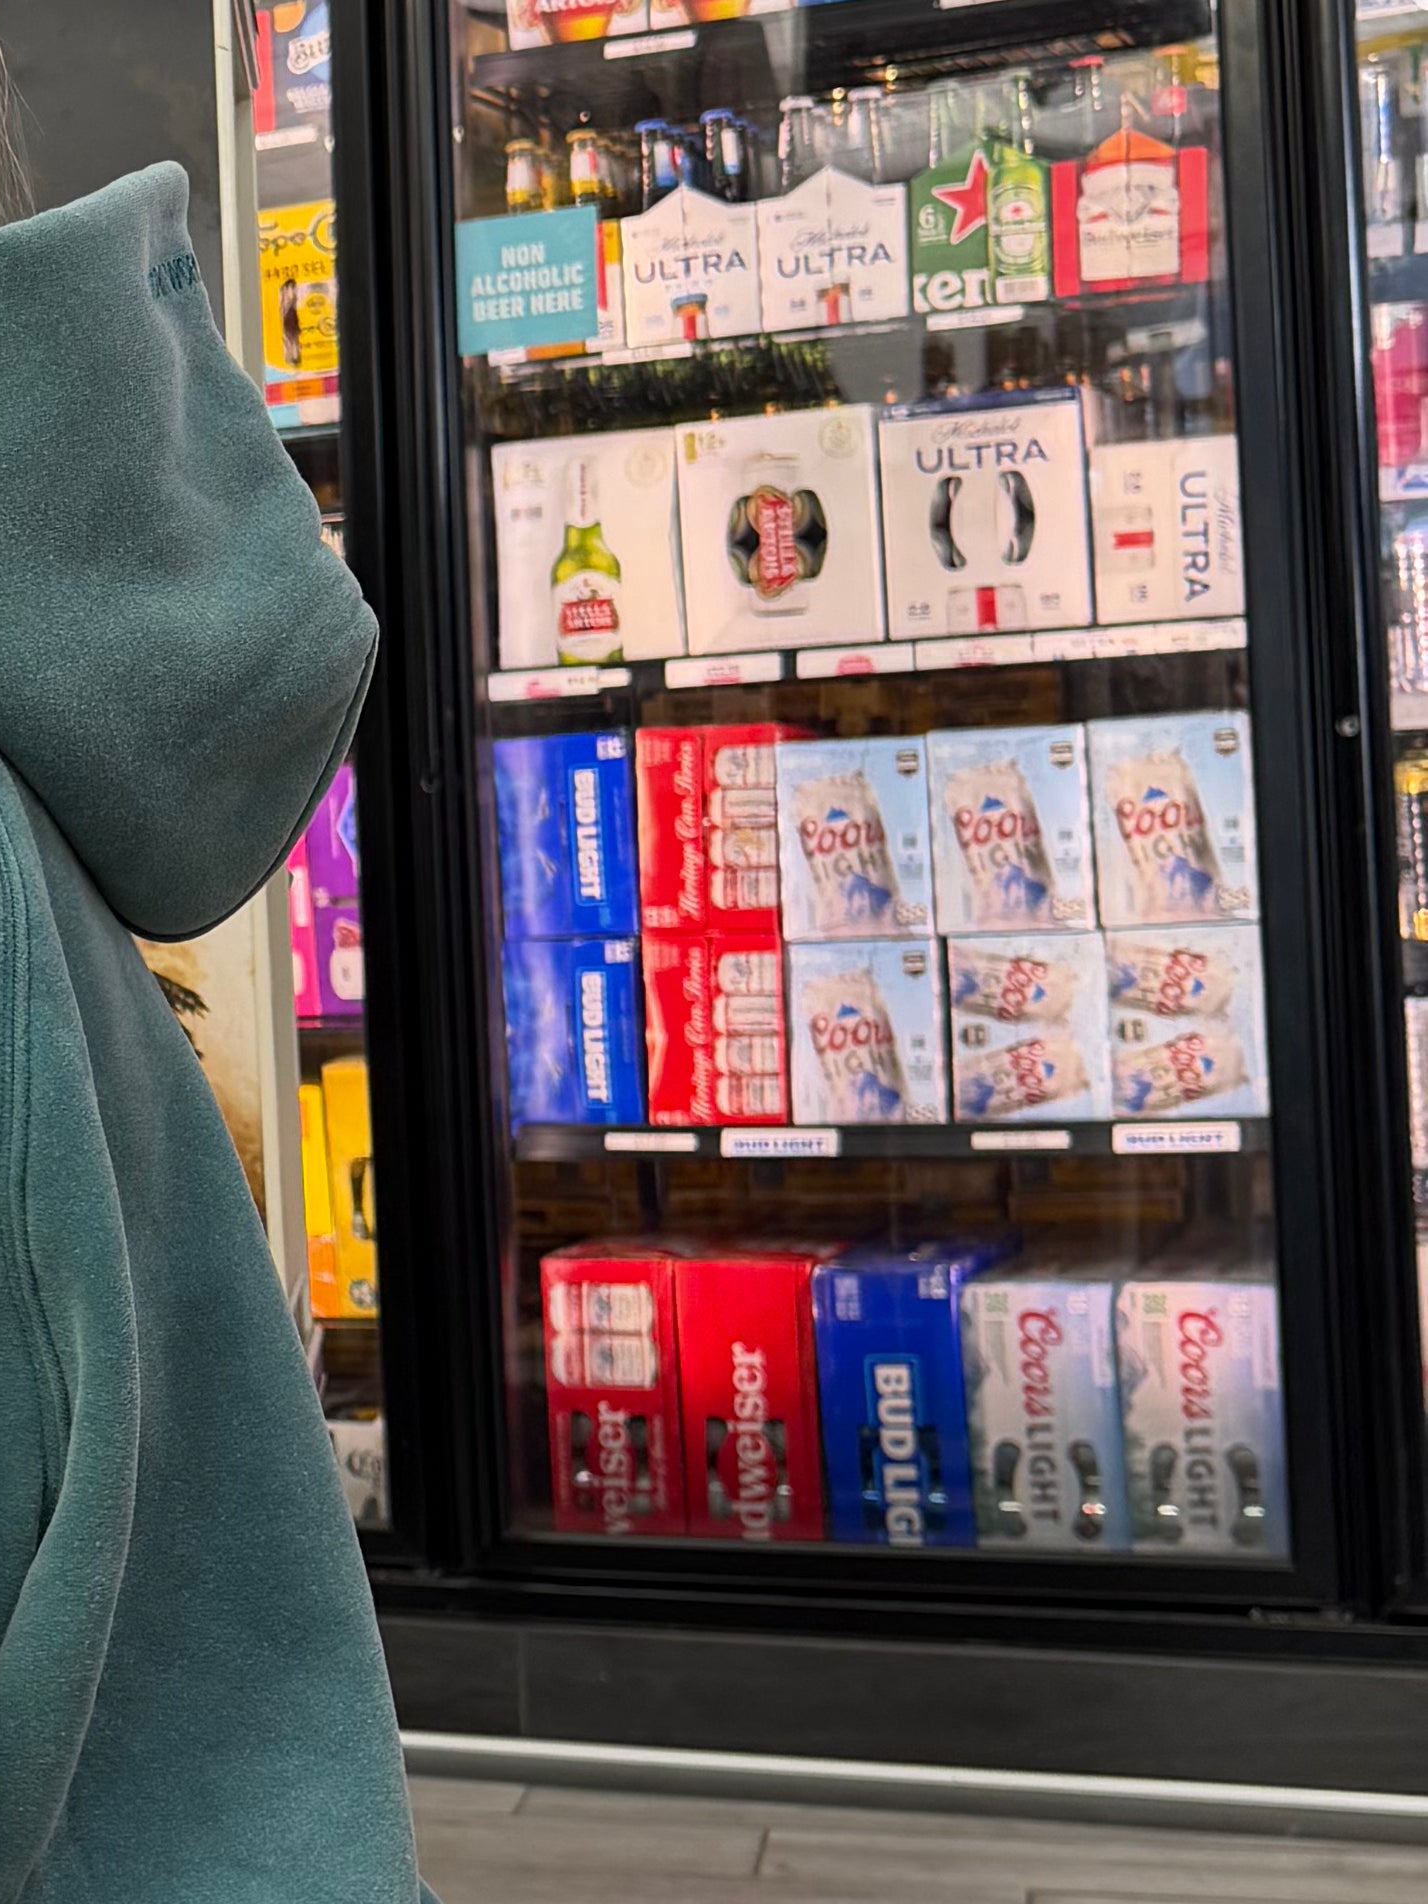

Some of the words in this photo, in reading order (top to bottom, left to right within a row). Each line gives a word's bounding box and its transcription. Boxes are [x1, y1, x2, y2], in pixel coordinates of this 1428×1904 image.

[471, 266, 585, 297] ALCOHOLIC
[500, 242, 545, 266] NON
[634, 251, 748, 284] ULTRA
[776, 243, 894, 278] ULTRA
[473, 297, 525, 323] BEER
[531, 290, 584, 317] HERE
[915, 437, 1048, 475] ULTRA
[1180, 469, 1211, 604] ULTRA
[574, 769, 599, 825] BUD
[576, 826, 602, 901] LIGHT
[580, 970, 604, 1025] BUD
[583, 1026, 610, 1104] LIGHT
[1017, 1306, 1065, 1419] Coors
[1176, 1307, 1226, 1421] Coors
[874, 1364, 917, 1461] BUD
[1026, 1423, 1062, 1523] LIGHT
[1184, 1426, 1218, 1531] LIGHT
